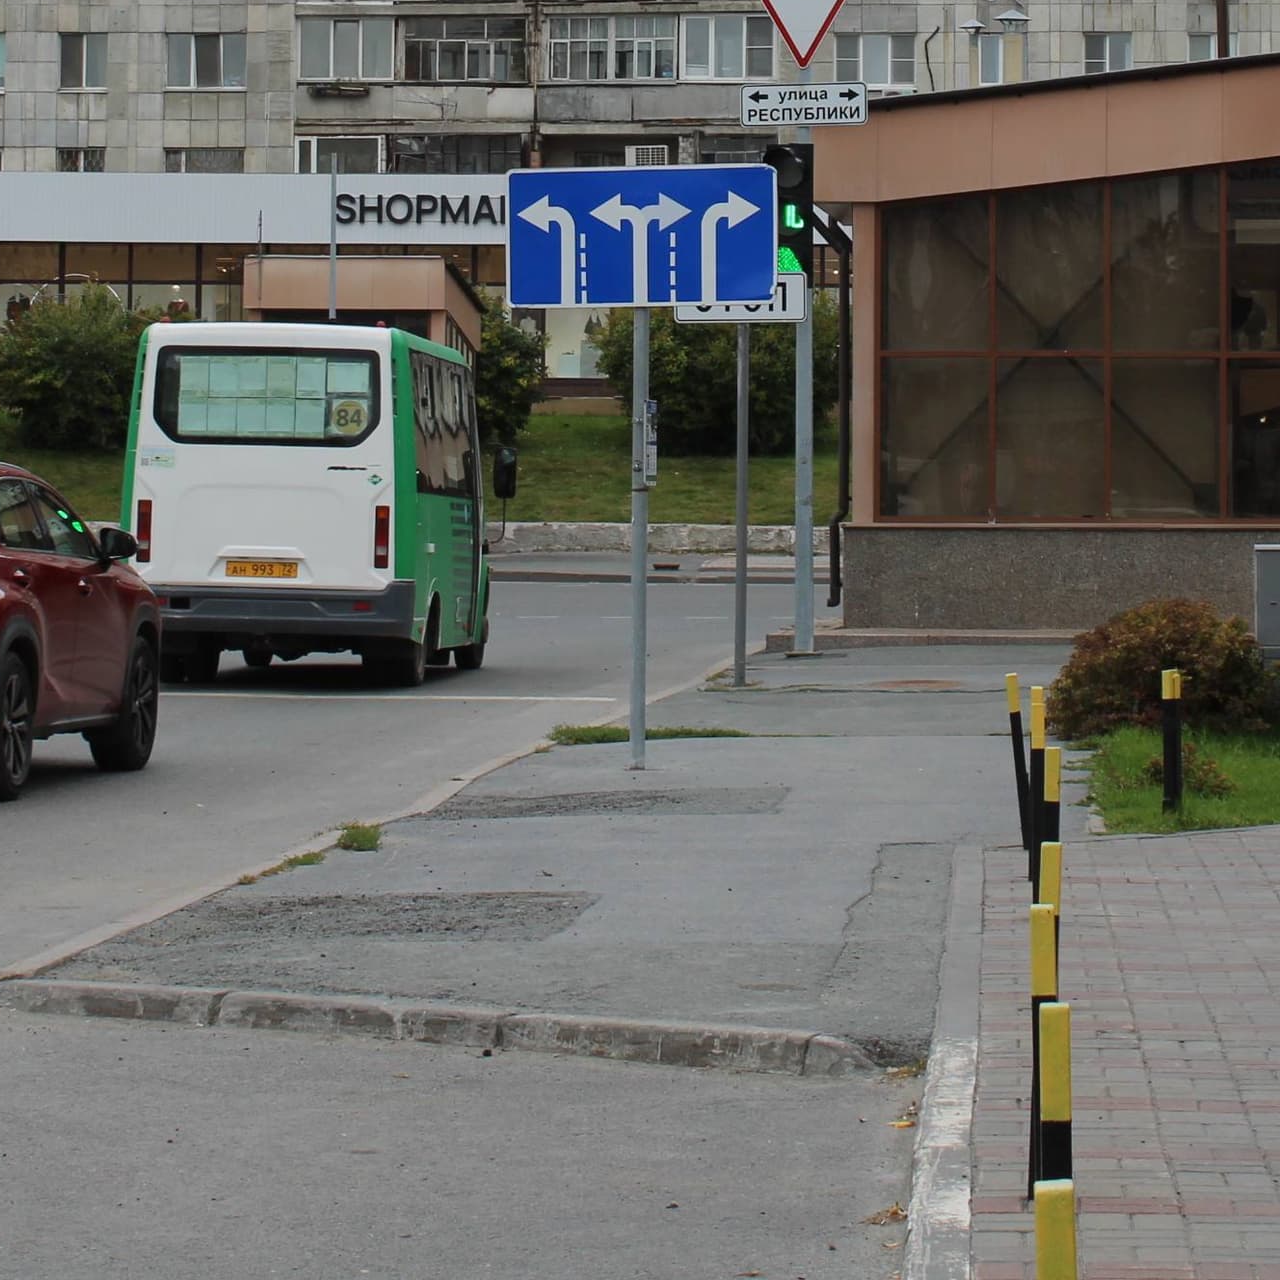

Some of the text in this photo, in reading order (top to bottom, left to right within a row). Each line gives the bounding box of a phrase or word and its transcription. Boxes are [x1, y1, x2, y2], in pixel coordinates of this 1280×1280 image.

[778, 89, 828, 105] улица
[747, 106, 861, 122] РЕСПУБЛИКИ
[336, 408, 362, 427] 84
[251, 563, 274, 576] 993
